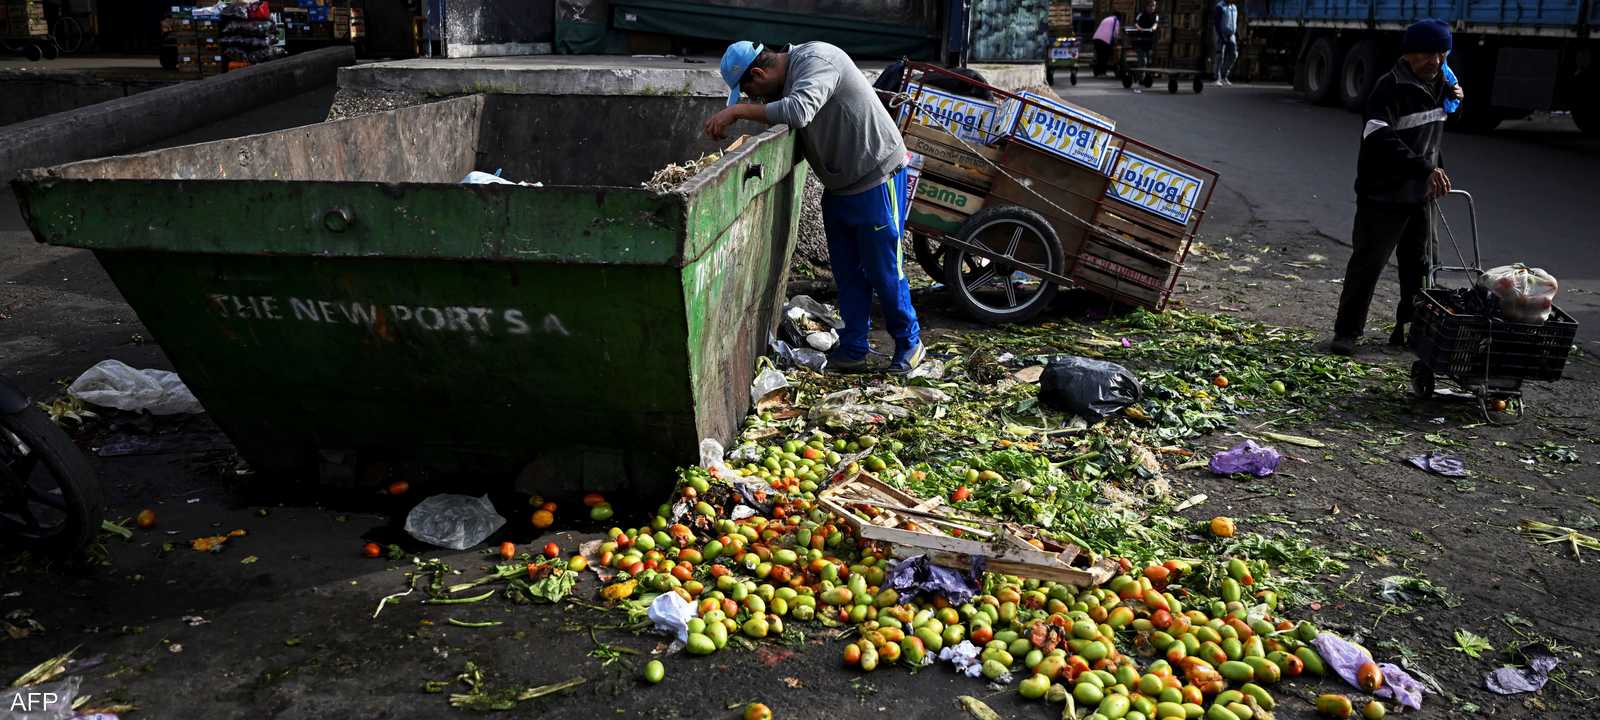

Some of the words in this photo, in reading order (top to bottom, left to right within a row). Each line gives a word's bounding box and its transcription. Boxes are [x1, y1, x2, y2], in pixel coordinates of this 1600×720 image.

[1035, 111, 1091, 147] Bolita
[1125, 169, 1179, 203] Bolita
[209, 293, 281, 320] THE
[290, 296, 377, 325] NEW
[390, 305, 493, 333] PORT
[504, 307, 529, 334] S
